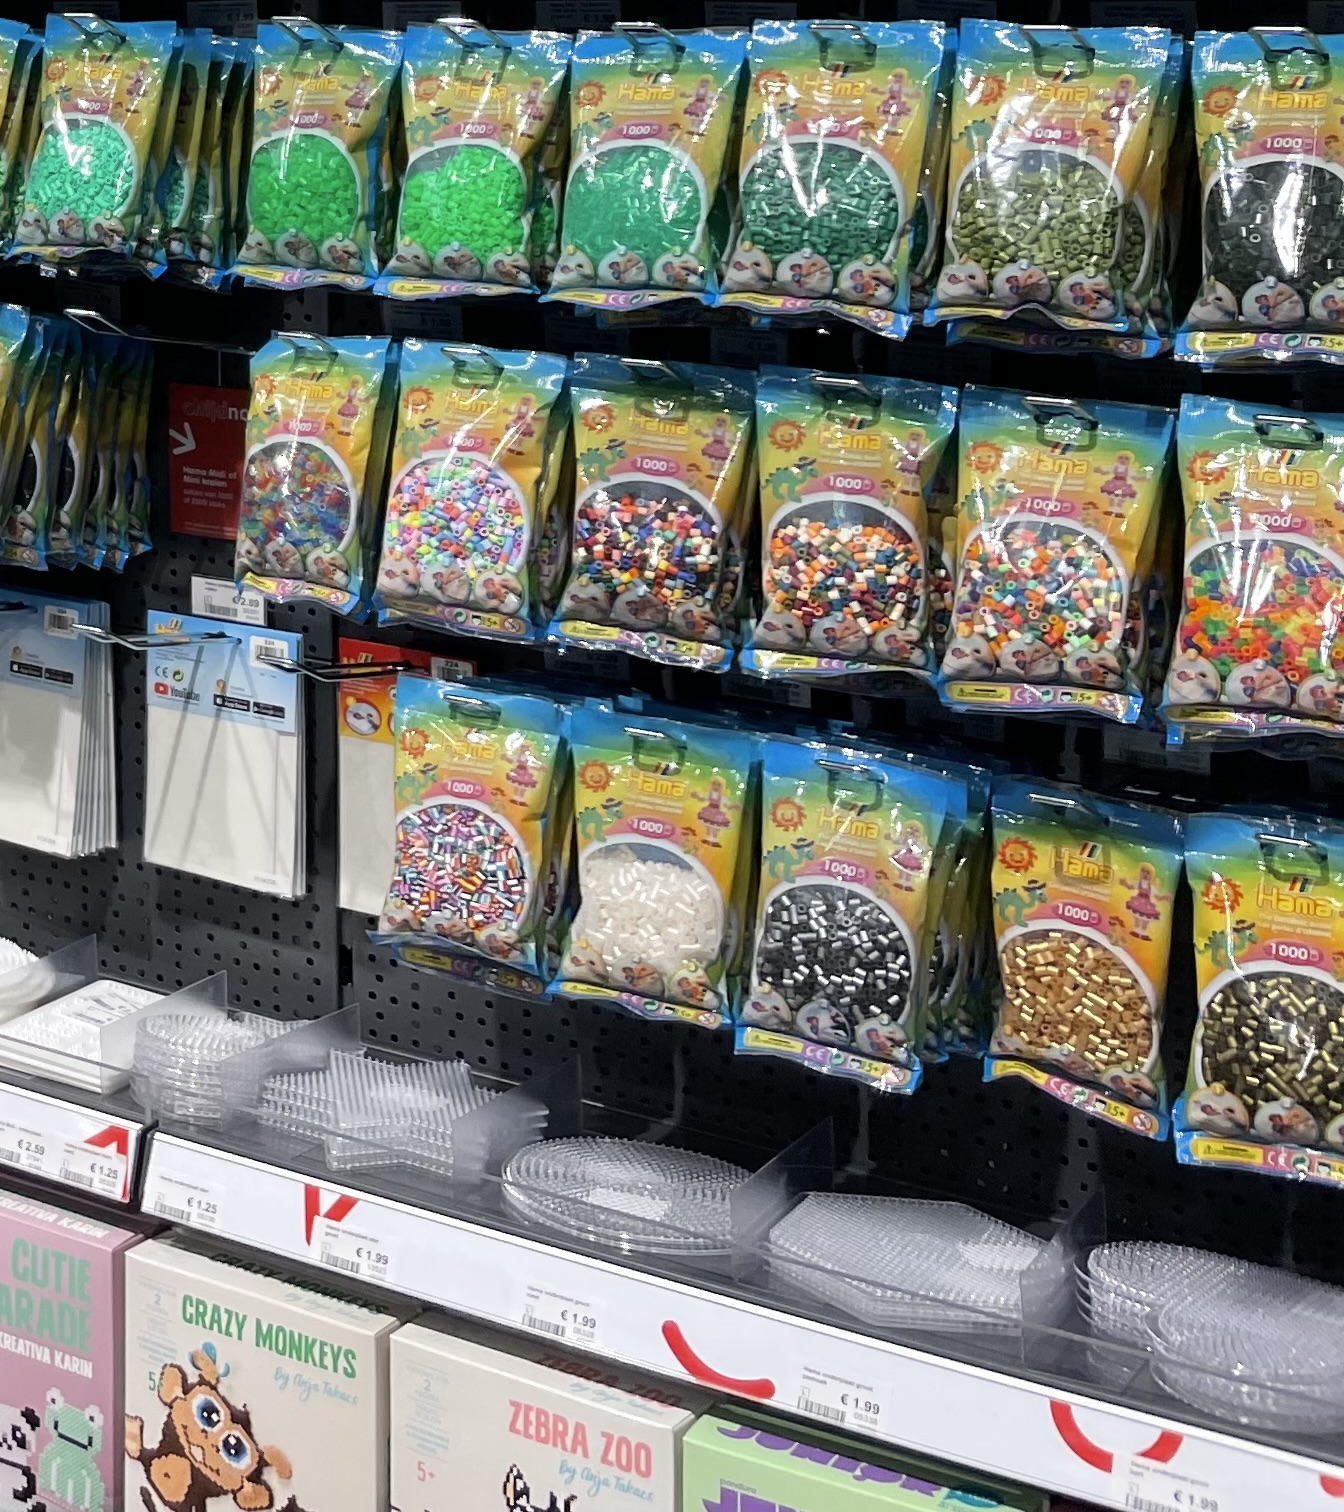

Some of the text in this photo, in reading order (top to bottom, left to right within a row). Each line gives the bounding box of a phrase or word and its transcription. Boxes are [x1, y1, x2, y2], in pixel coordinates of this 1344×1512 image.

[617, 83, 675, 101] Hama
[1257, 90, 1329, 110] Hama
[622, 124, 651, 138] 1000
[1265, 136, 1303, 150] 1000
[819, 428, 882, 451] Hama
[635, 457, 669, 472] 1000
[1017, 453, 1089, 475] Hama
[828, 476, 863, 490] 1000
[1026, 498, 1062, 513] 1000
[445, 780, 476, 796] 1000
[628, 771, 686, 798] Hama
[631, 817, 664, 835] 1000
[817, 810, 878, 840] Hama
[824, 860, 857, 878] 1000
[1050, 846, 1113, 882] Hama
[1257, 885, 1334, 918] Hama
[1056, 901, 1090, 923] 1000
[1269, 942, 1310, 961] 1000
[196, 1199, 218, 1215] 1.25
[366, 1249, 389, 1265] 1.99
[11, 1237, 92, 1303] CUTIE
[571, 1310, 596, 1329] 1.99
[182, 1294, 357, 1379] CRAZY MONKEYS
[54, 1347, 93, 1379] KARIN
[852, 1395, 880, 1416] 1.99
[509, 1399, 653, 1480] ZEBRA ZOO
[416, 1462, 435, 1482] 5+
[558, 1460, 577, 1480] By
